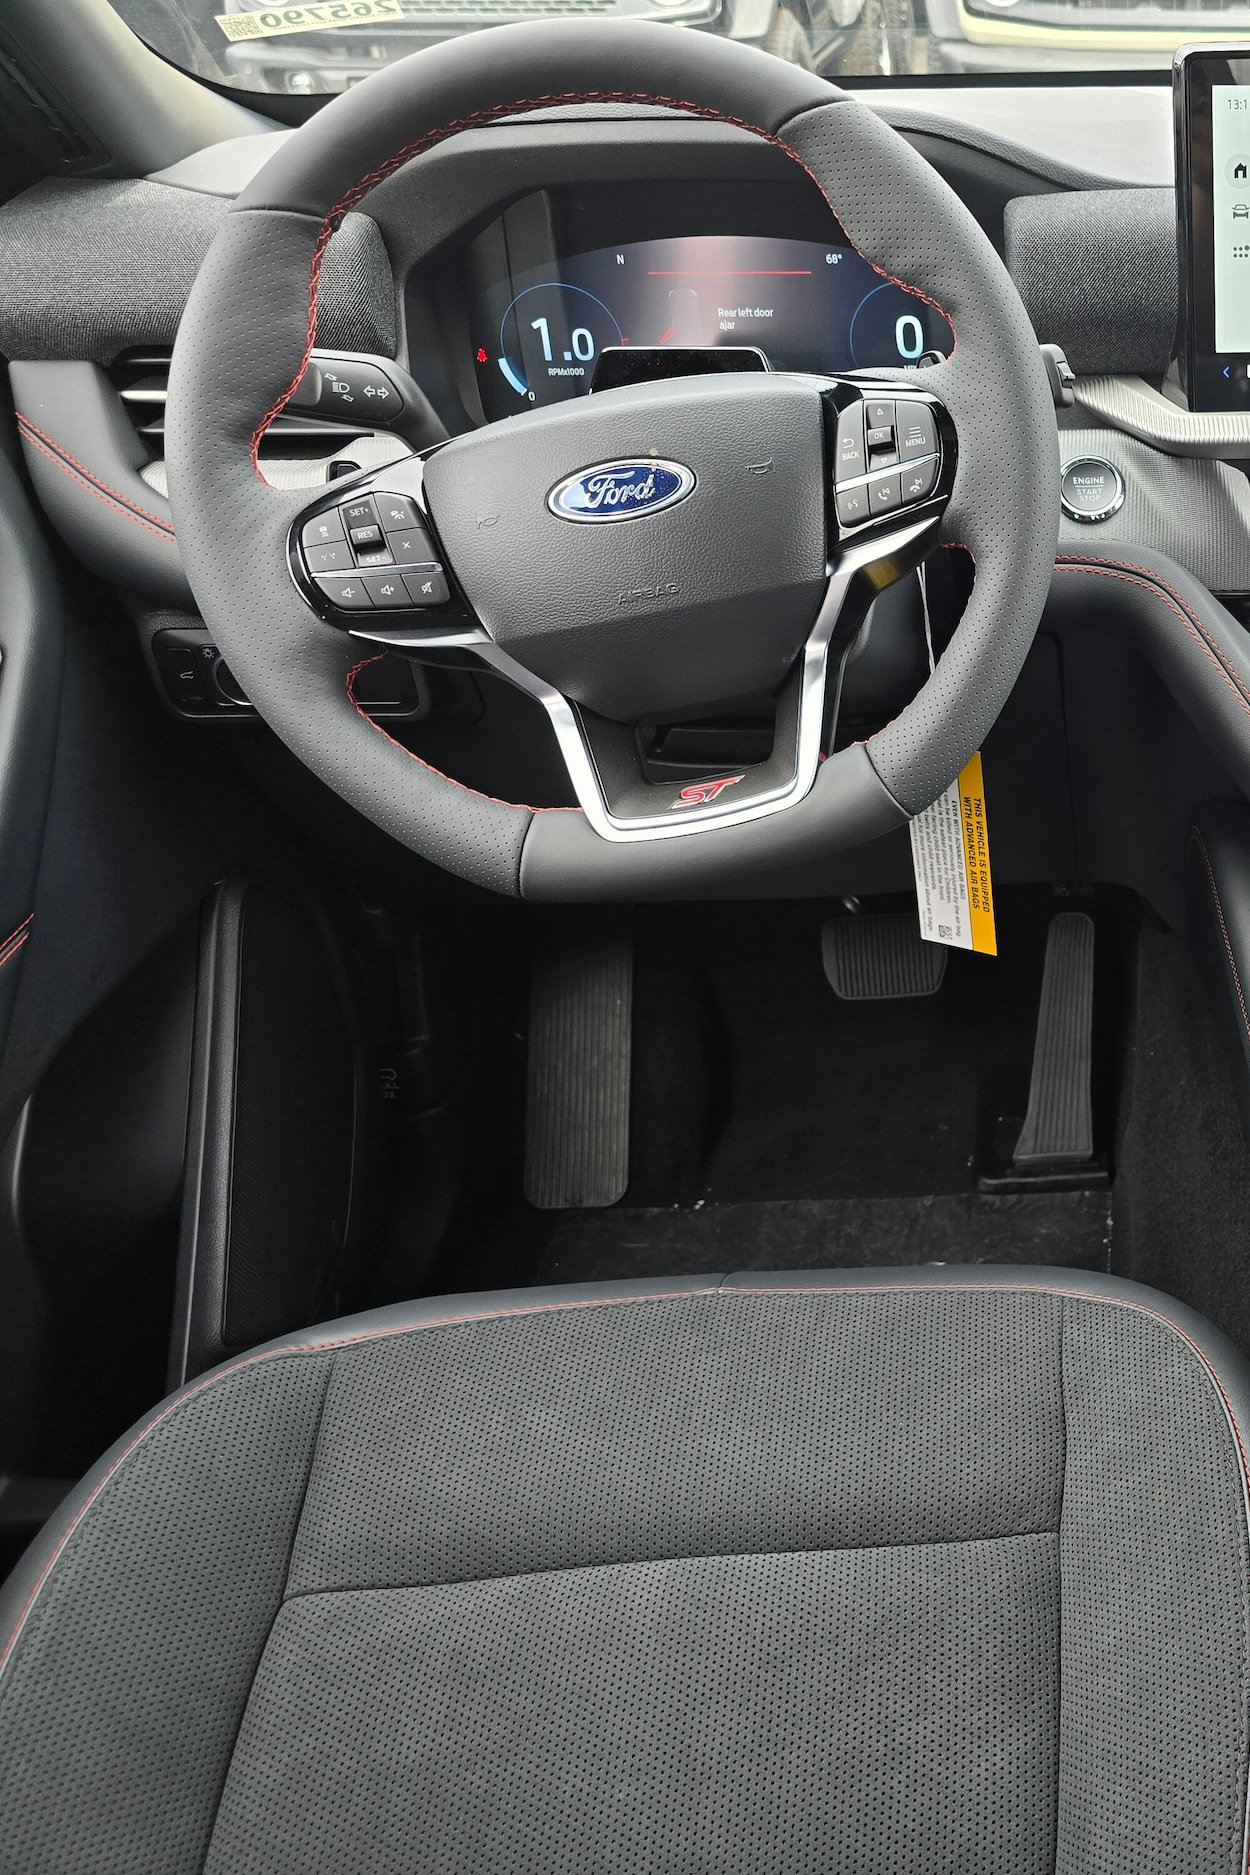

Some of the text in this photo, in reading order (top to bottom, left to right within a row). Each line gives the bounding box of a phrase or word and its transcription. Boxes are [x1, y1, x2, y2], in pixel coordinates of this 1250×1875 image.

[616, 254, 625, 265] N
[825, 253, 842, 265] 68°
[717, 307, 774, 318] Rear left door
[719, 320, 736, 331] ajar
[531, 317, 595, 362] 1.0
[895, 315, 924, 359] 0
[547, 367, 585, 377] RPMx1000
[873, 432, 884, 440] OK
[905, 437, 926, 447] MENU
[841, 450, 860, 461] BACK
[1072, 476, 1105, 485] ENGINE
[584, 471, 656, 508] Ford
[1076, 488, 1102, 496] START
[1079, 494, 1102, 502] STOP
[357, 531, 374, 540] RES
[618, 583, 681, 605] AIRBAG
[669, 775, 745, 809] ST
[964, 797, 972, 819] WITH
[974, 798, 982, 817] THIS
[966, 822, 976, 867] ADVANCED
[976, 821, 985, 857] VEHICLE
[980, 871, 989, 912] EQUIPPED
[972, 887, 980, 909] BAGS
